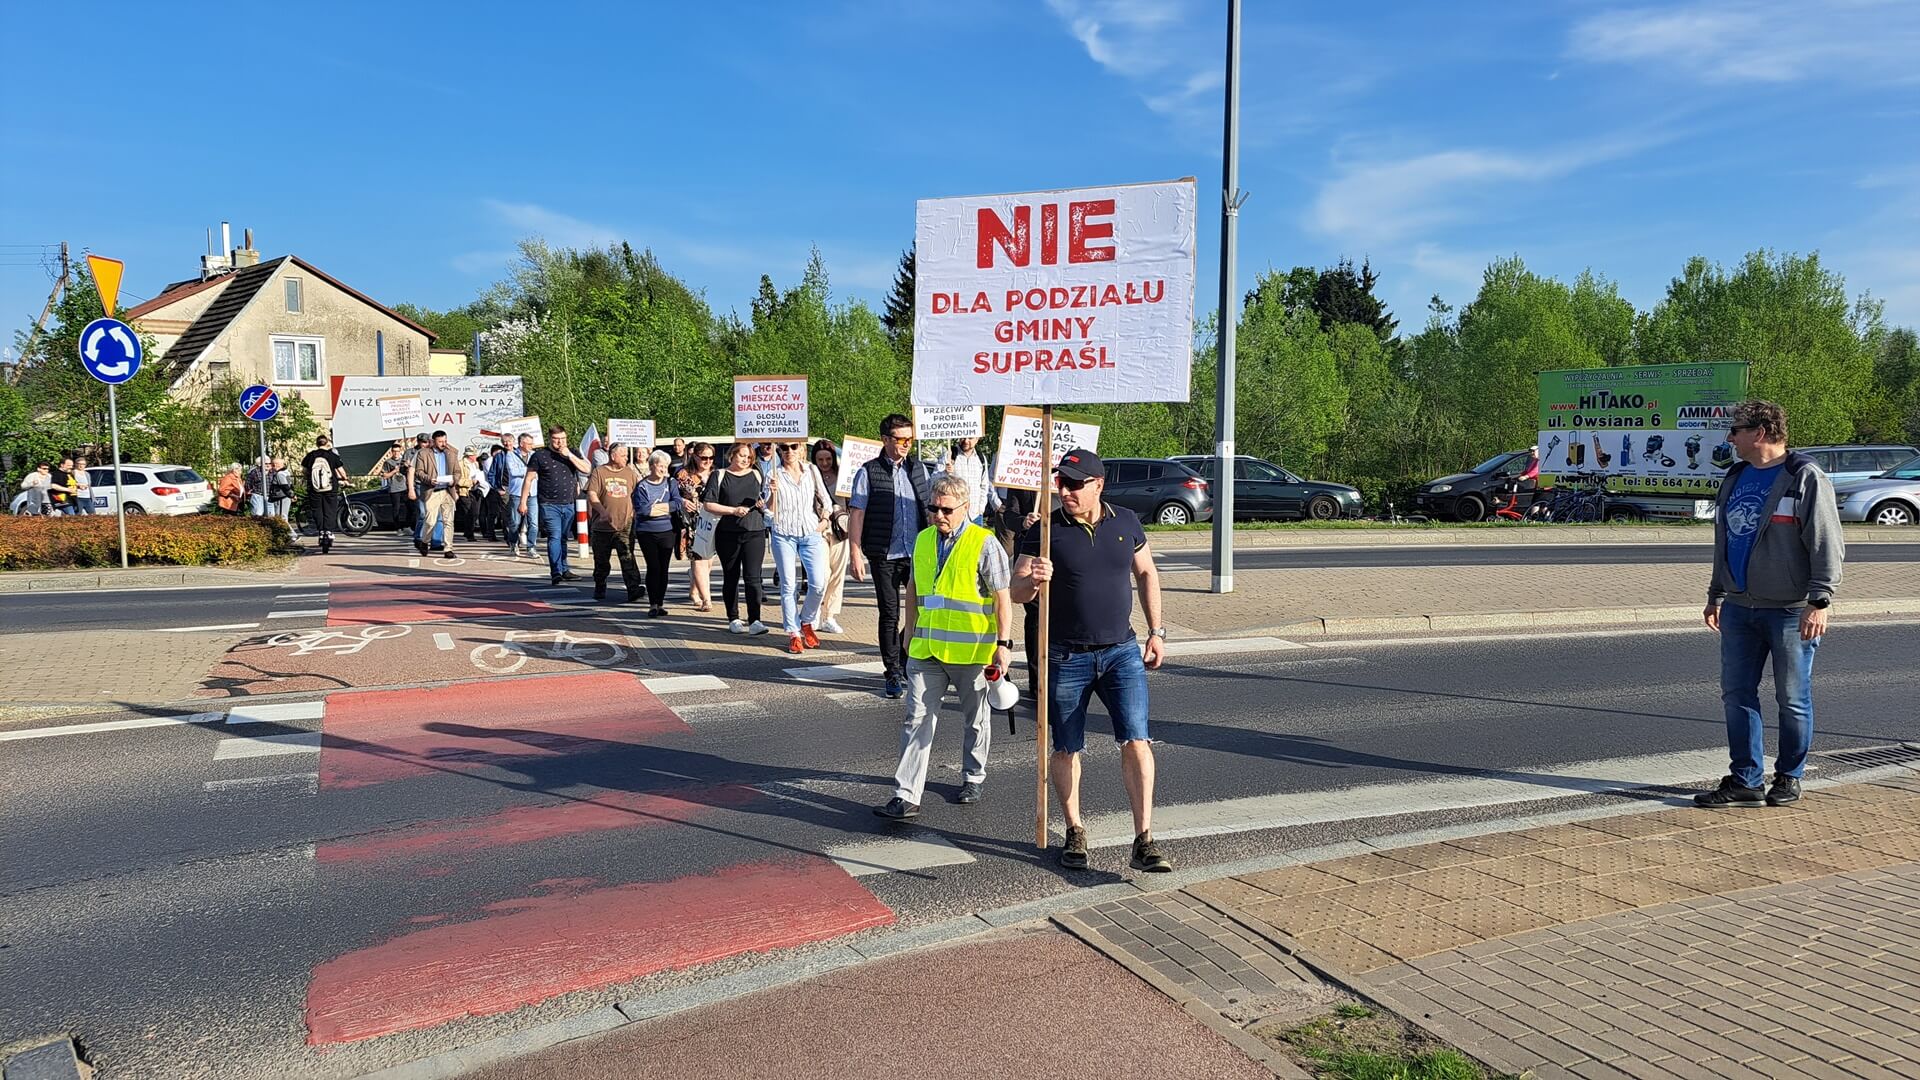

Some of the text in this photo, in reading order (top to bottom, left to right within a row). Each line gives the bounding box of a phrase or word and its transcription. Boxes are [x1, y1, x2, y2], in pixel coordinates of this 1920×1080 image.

[977, 199, 1116, 269] NIE
[932, 280, 1164, 314] DLA PODZIAŁU
[994, 316, 1096, 343] GMINY
[973, 341, 1115, 374] SUPRAŚL
[741, 392, 787, 402] MIESZKAĆ
[738, 403, 805, 412] BIAŁYMSTOKU?
[923, 405, 973, 414] PRZECIWKO
[1679, 406, 1731, 418] AMMAN
[427, 412, 466, 424] VAT
[1548, 413, 1661, 428] ul. Owsiana 6
[921, 421, 978, 430] BLOKOWANIA
[924, 429, 976, 438] REFERNDUM
[1010, 477, 1032, 486] WOJ.
[1645, 478, 1658, 487] 85
[1662, 479, 1682, 487] 664
[1687, 479, 1700, 488] 74
[1705, 480, 1720, 489] 40
